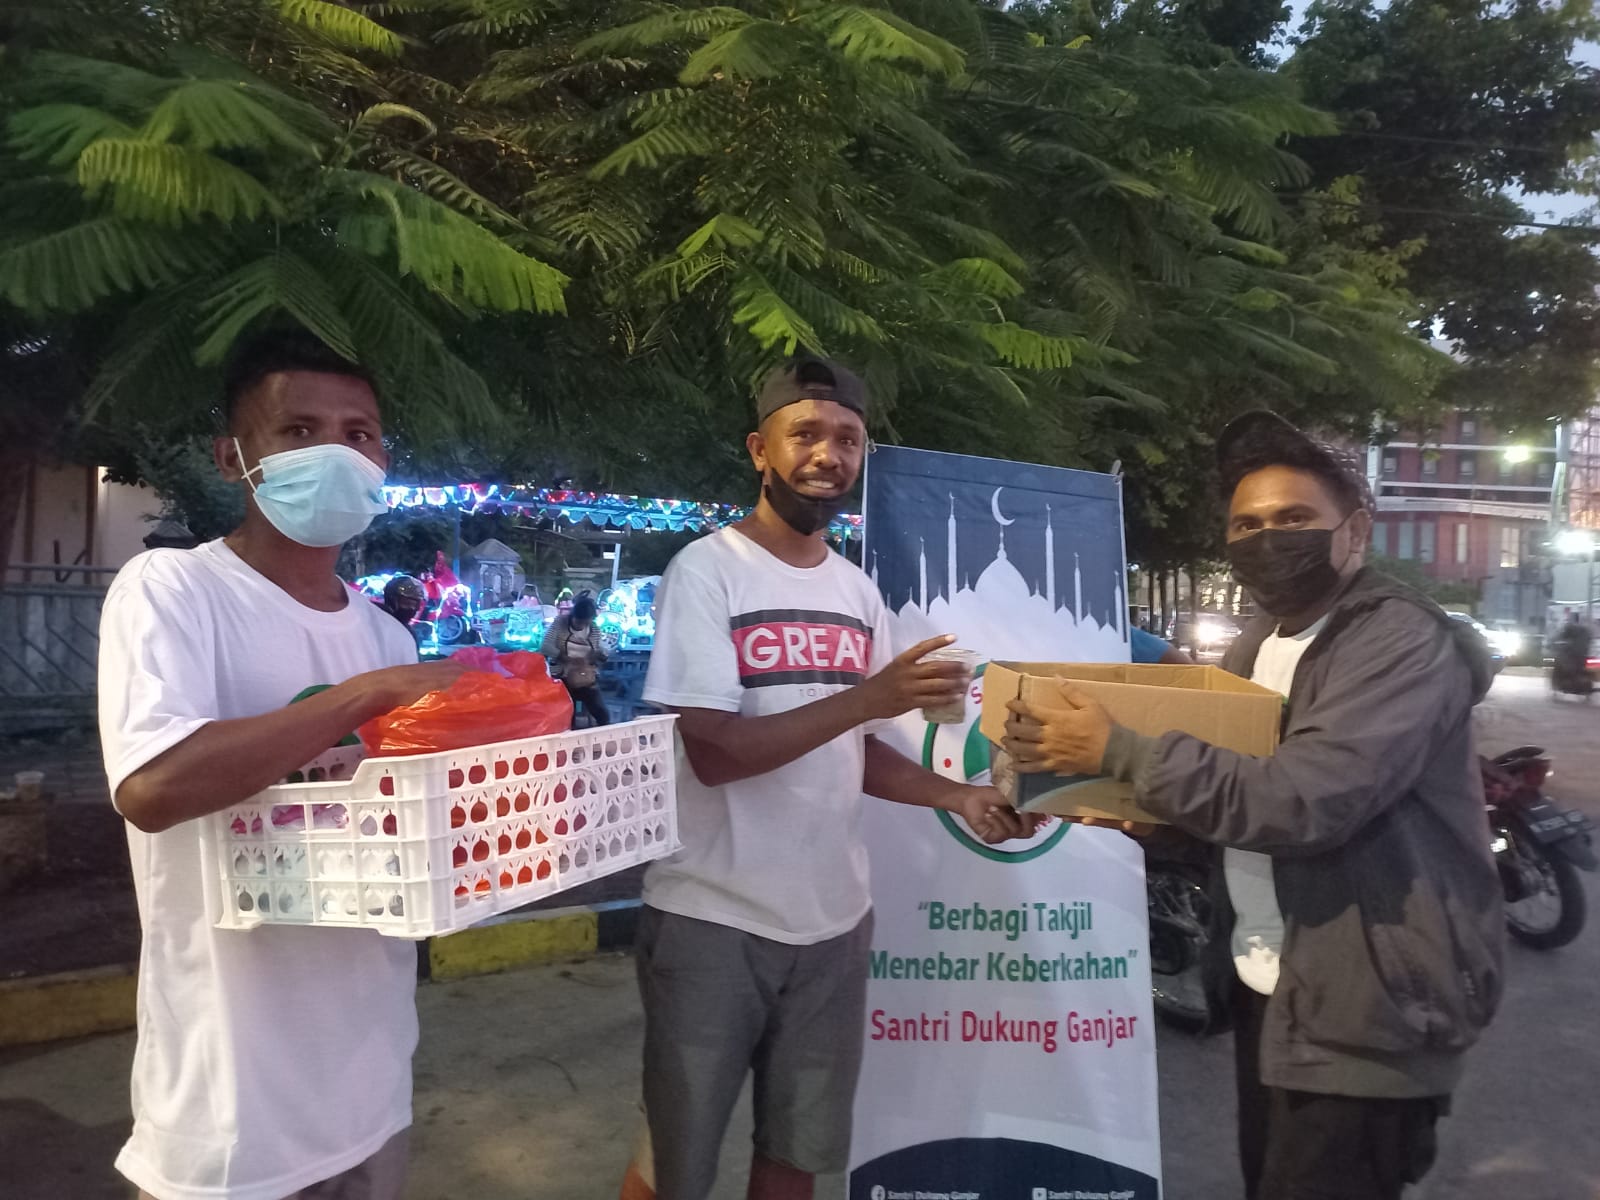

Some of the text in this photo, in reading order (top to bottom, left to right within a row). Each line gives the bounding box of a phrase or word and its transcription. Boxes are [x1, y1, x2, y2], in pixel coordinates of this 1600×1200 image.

[743, 626, 866, 669] GREAT
[1034, 902, 1092, 940] Takjil
[868, 950, 980, 980] Menebar
[870, 1009, 1138, 1053] Santri Dukung Ganjar
